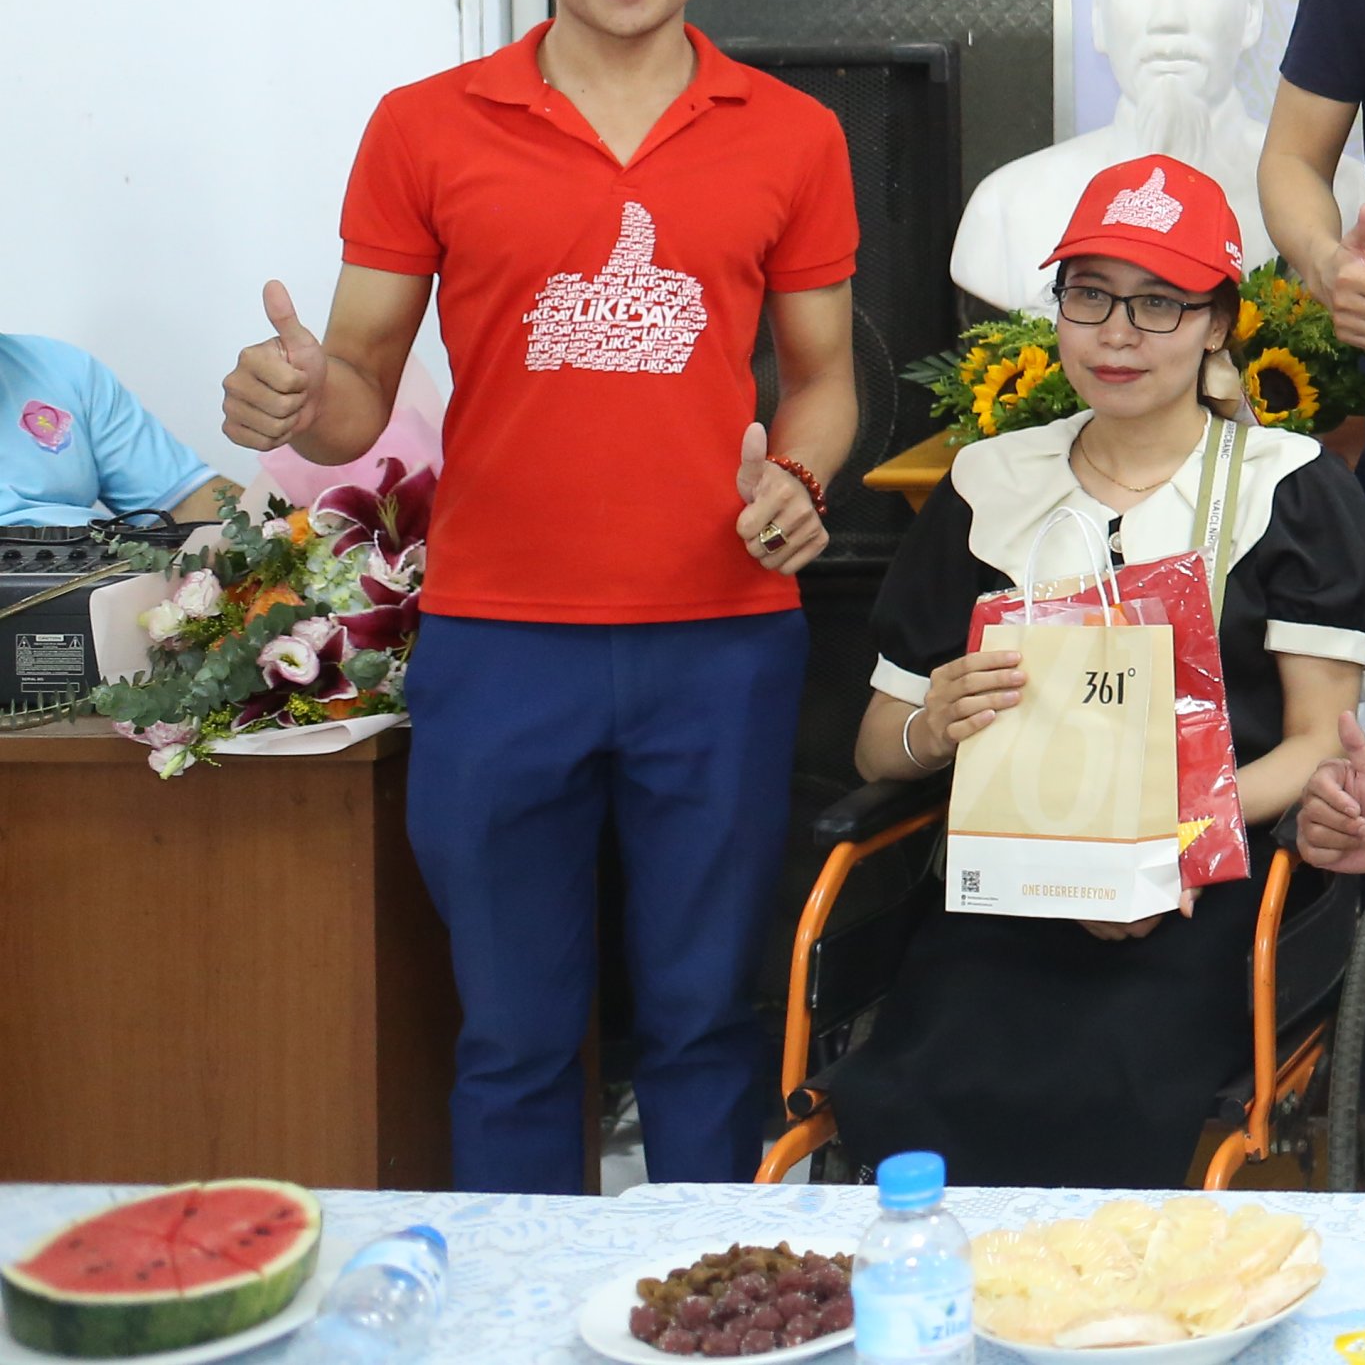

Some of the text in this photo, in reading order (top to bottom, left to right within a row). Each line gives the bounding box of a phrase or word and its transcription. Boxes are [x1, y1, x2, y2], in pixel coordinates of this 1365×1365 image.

[1082, 667, 1137, 705] 361°
[1022, 884, 1116, 900] ONE DEGREE BEYOND
